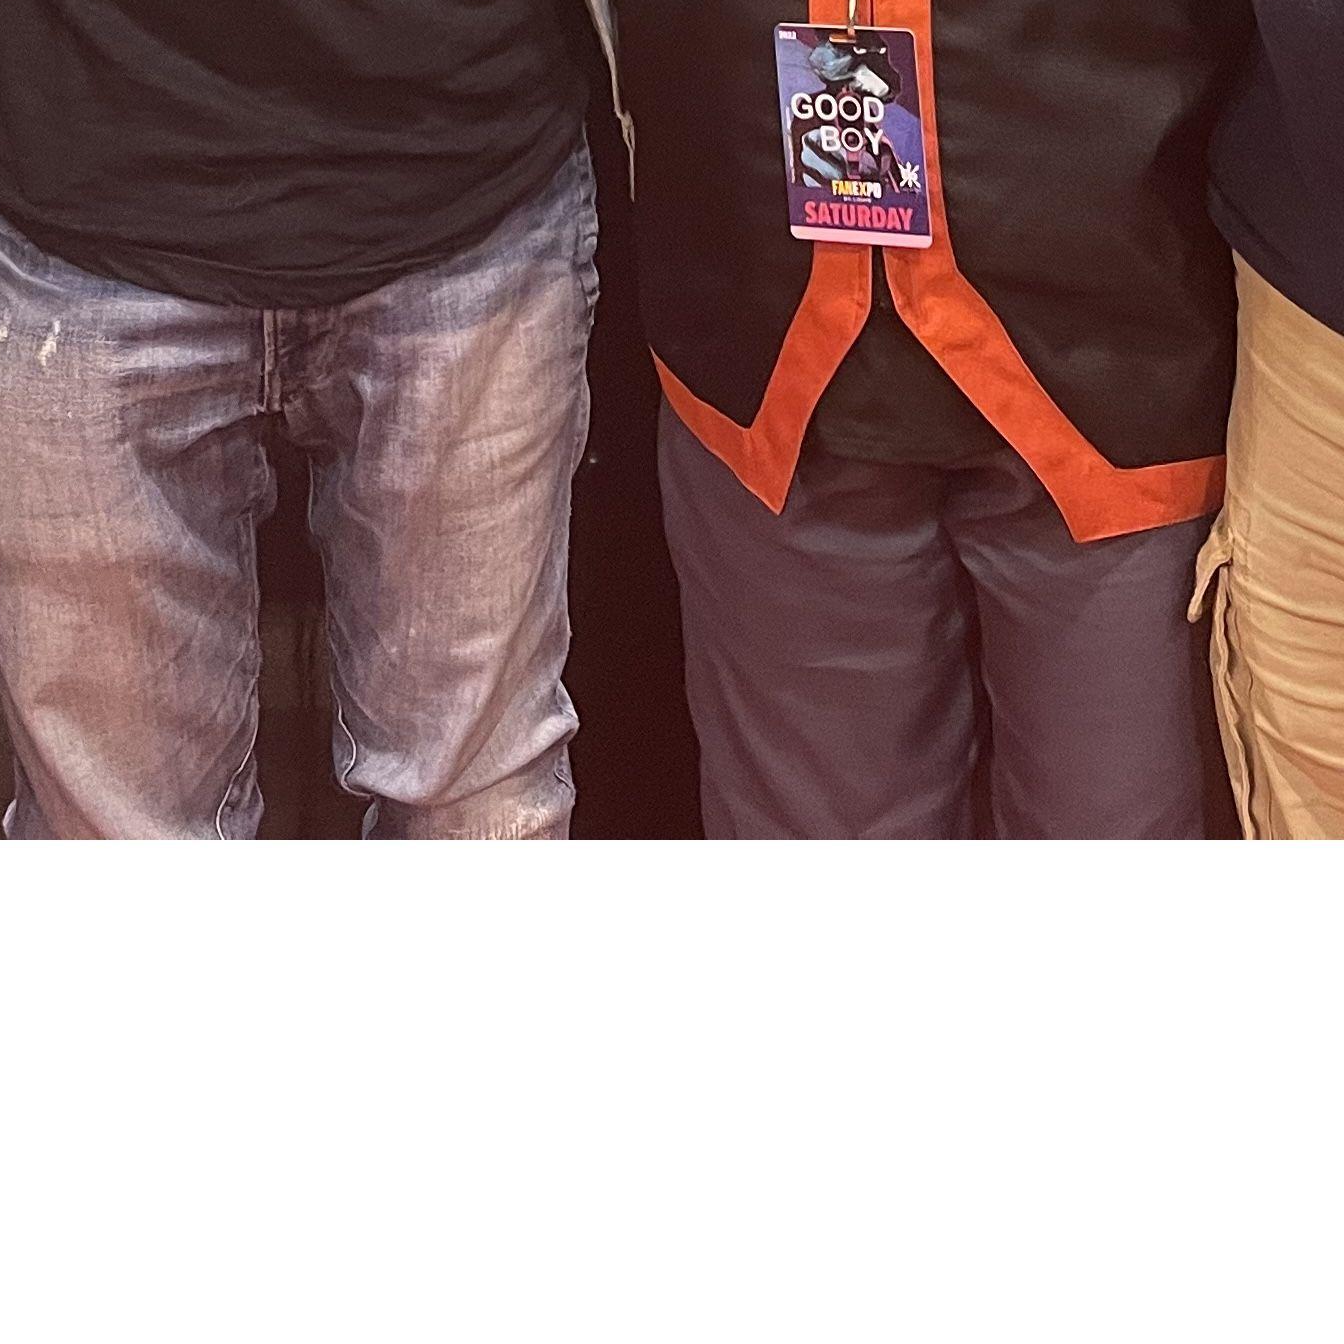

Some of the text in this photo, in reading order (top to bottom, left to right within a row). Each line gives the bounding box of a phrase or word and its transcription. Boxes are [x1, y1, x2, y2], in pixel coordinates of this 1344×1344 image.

[791, 92, 884, 123] GOOD
[820, 125, 884, 156] BOY
[831, 179, 883, 199] FANEXPO
[805, 200, 913, 231] SATURDAY
